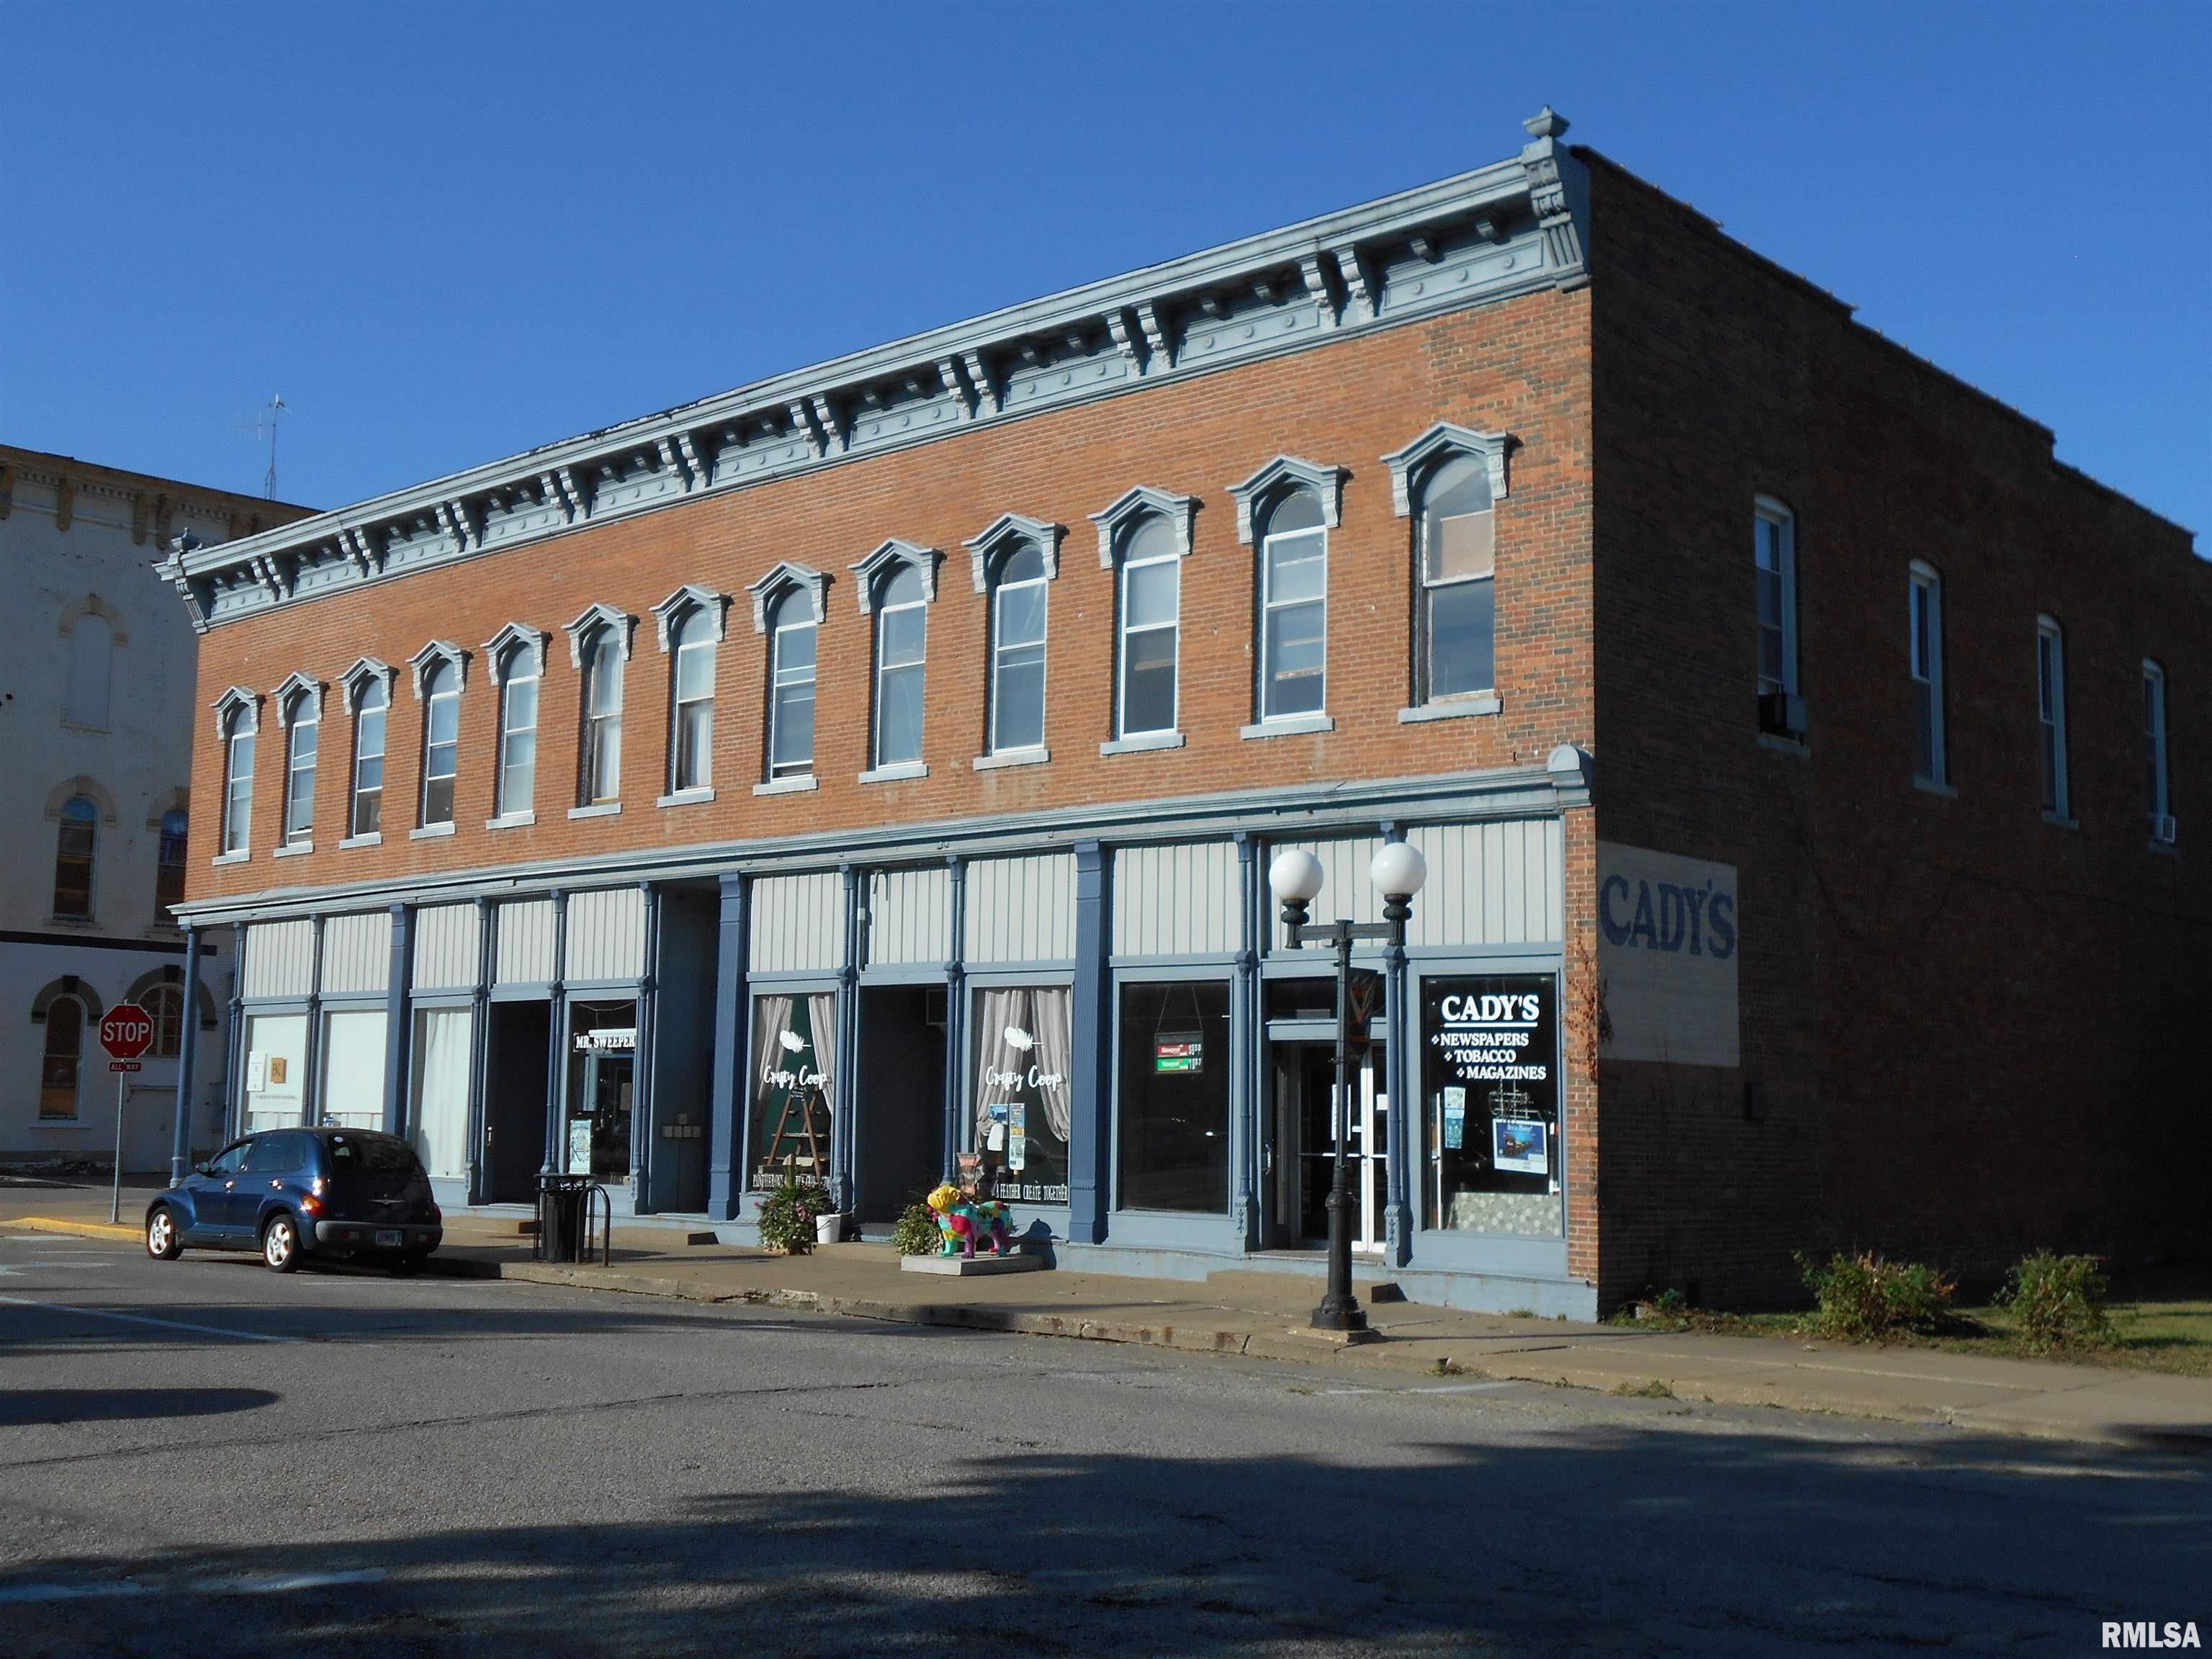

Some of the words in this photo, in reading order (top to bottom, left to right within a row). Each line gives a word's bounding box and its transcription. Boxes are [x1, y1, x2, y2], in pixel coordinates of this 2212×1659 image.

[1599, 874, 1735, 959] CADY'S
[1441, 994, 1539, 1021] CADY'S
[103, 1021, 149, 1042] STOP
[1440, 1033, 1529, 1046] NEWSPAPERS
[576, 1035, 592, 1048] MR.
[593, 1035, 635, 1048] SWEEPER
[1454, 1049, 1516, 1063] TOBACCO
[763, 1066, 796, 1090] Crafty
[799, 1065, 827, 1090] Coop
[986, 1066, 1024, 1092] Crafty
[1028, 1065, 1061, 1092] Coop
[1466, 1066, 1547, 1080] MAGAZINES
[1000, 1183, 1020, 1199] FEATHER
[1023, 1184, 1041, 1200] CREATE
[1043, 1185, 1068, 1200] TOGETHER
